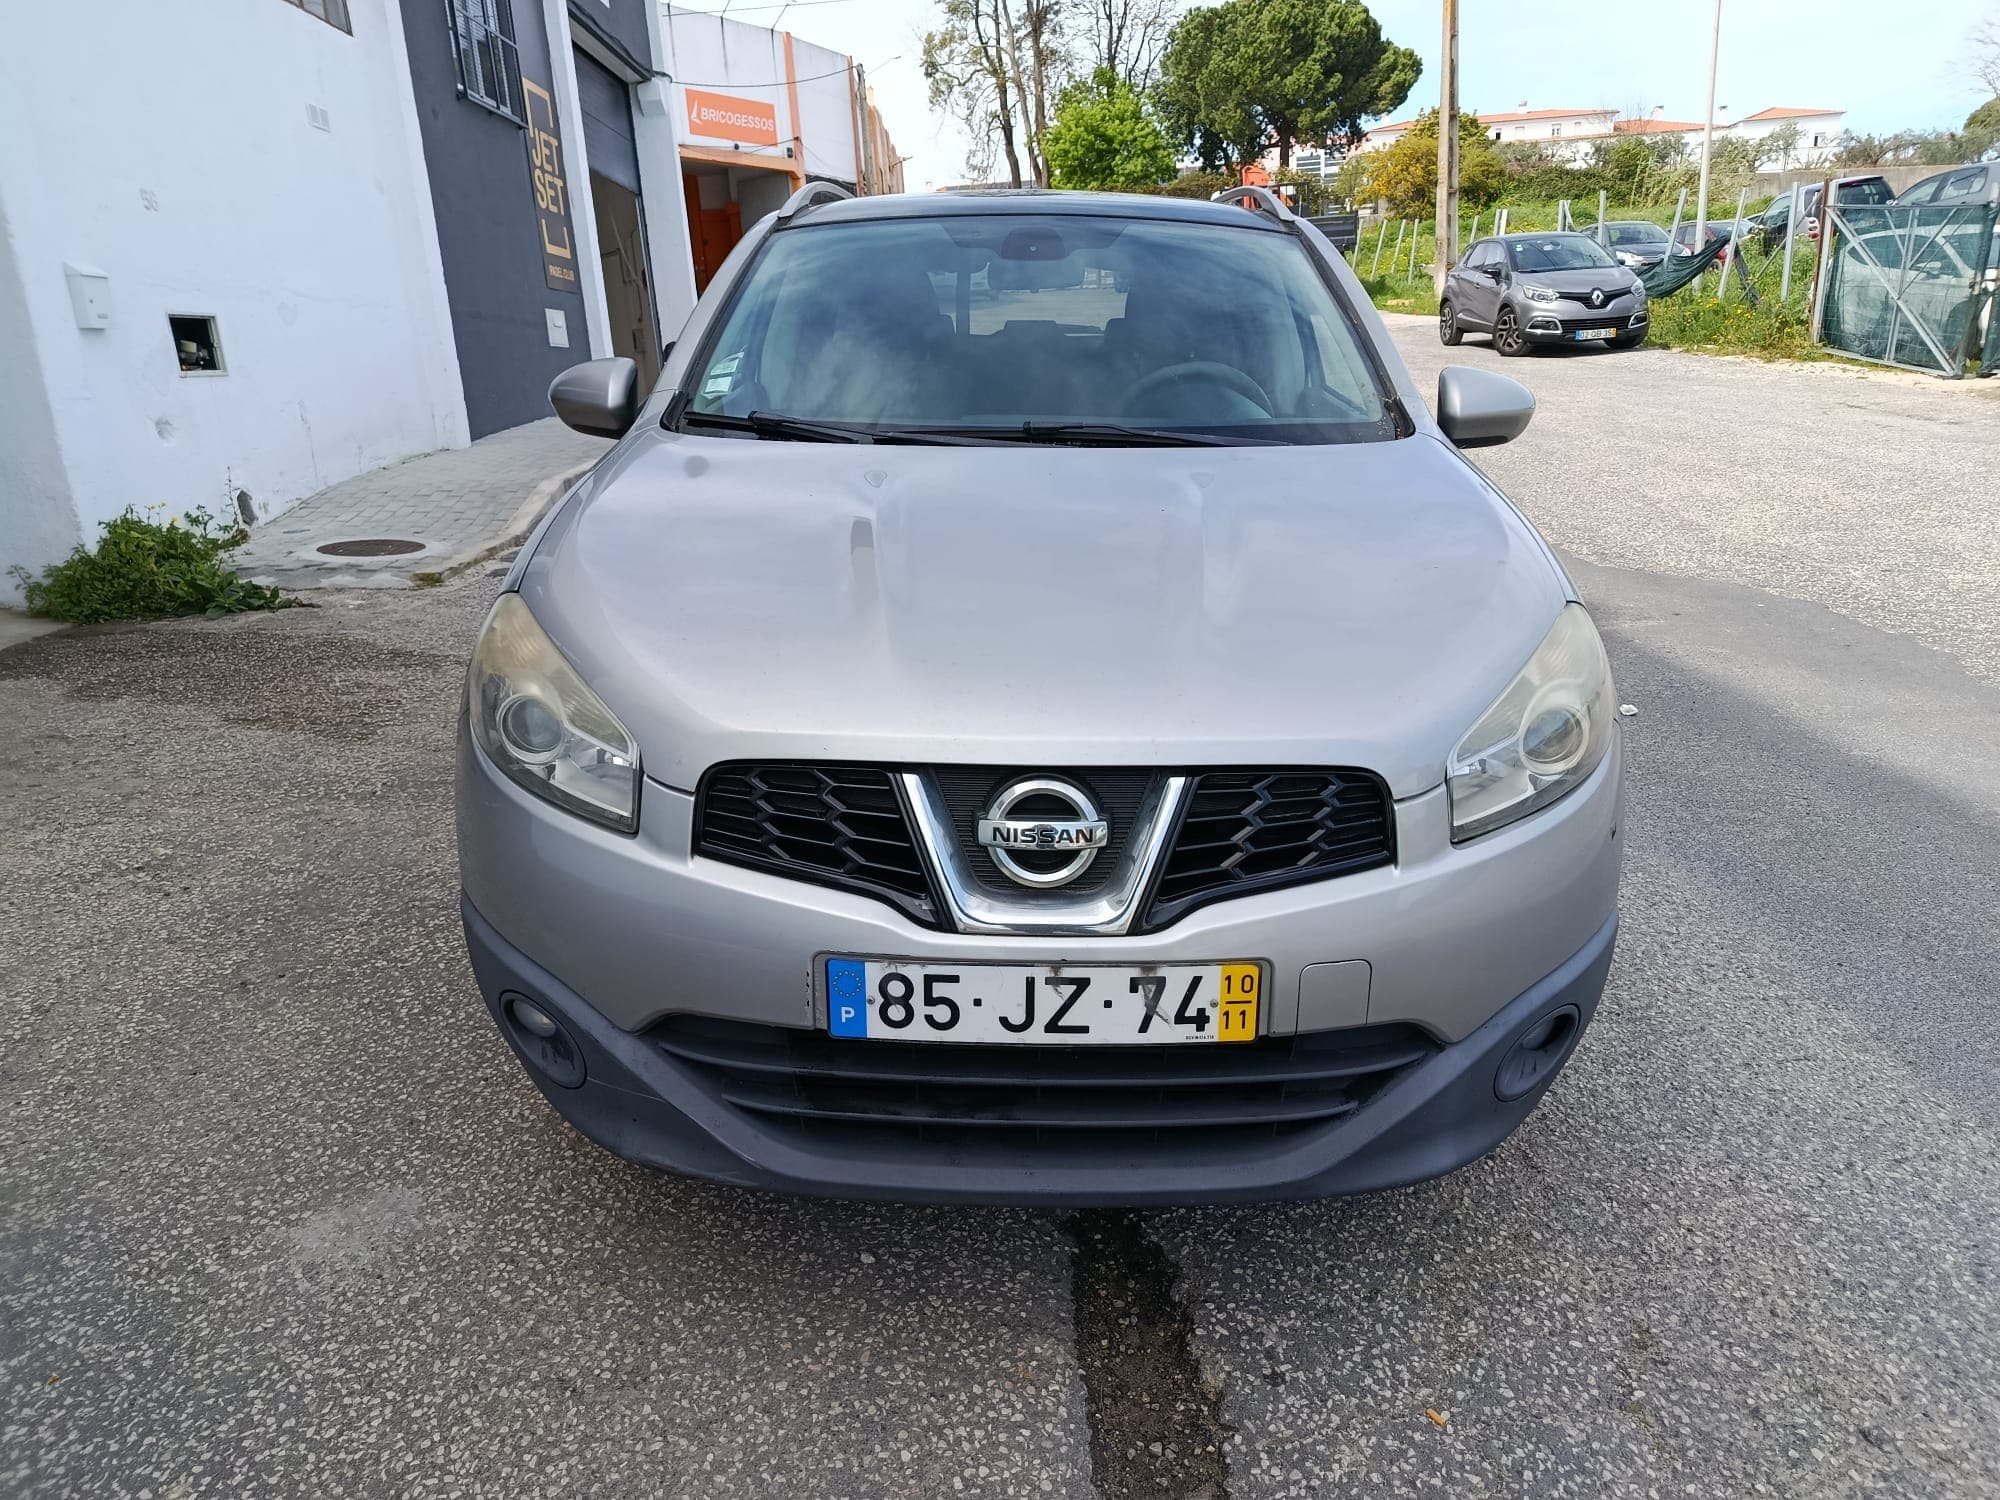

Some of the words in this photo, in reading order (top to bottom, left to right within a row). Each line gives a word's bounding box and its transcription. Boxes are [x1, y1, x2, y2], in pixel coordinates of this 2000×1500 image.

[701, 107, 775, 132] BRICOGESSOS
[532, 127, 559, 175] JET
[534, 169, 565, 216] SET
[992, 827, 1094, 845] NISSAN
[1224, 974, 1254, 994] 10
[840, 1006, 855, 1023] P
[1222, 1009, 1247, 1030] 11
